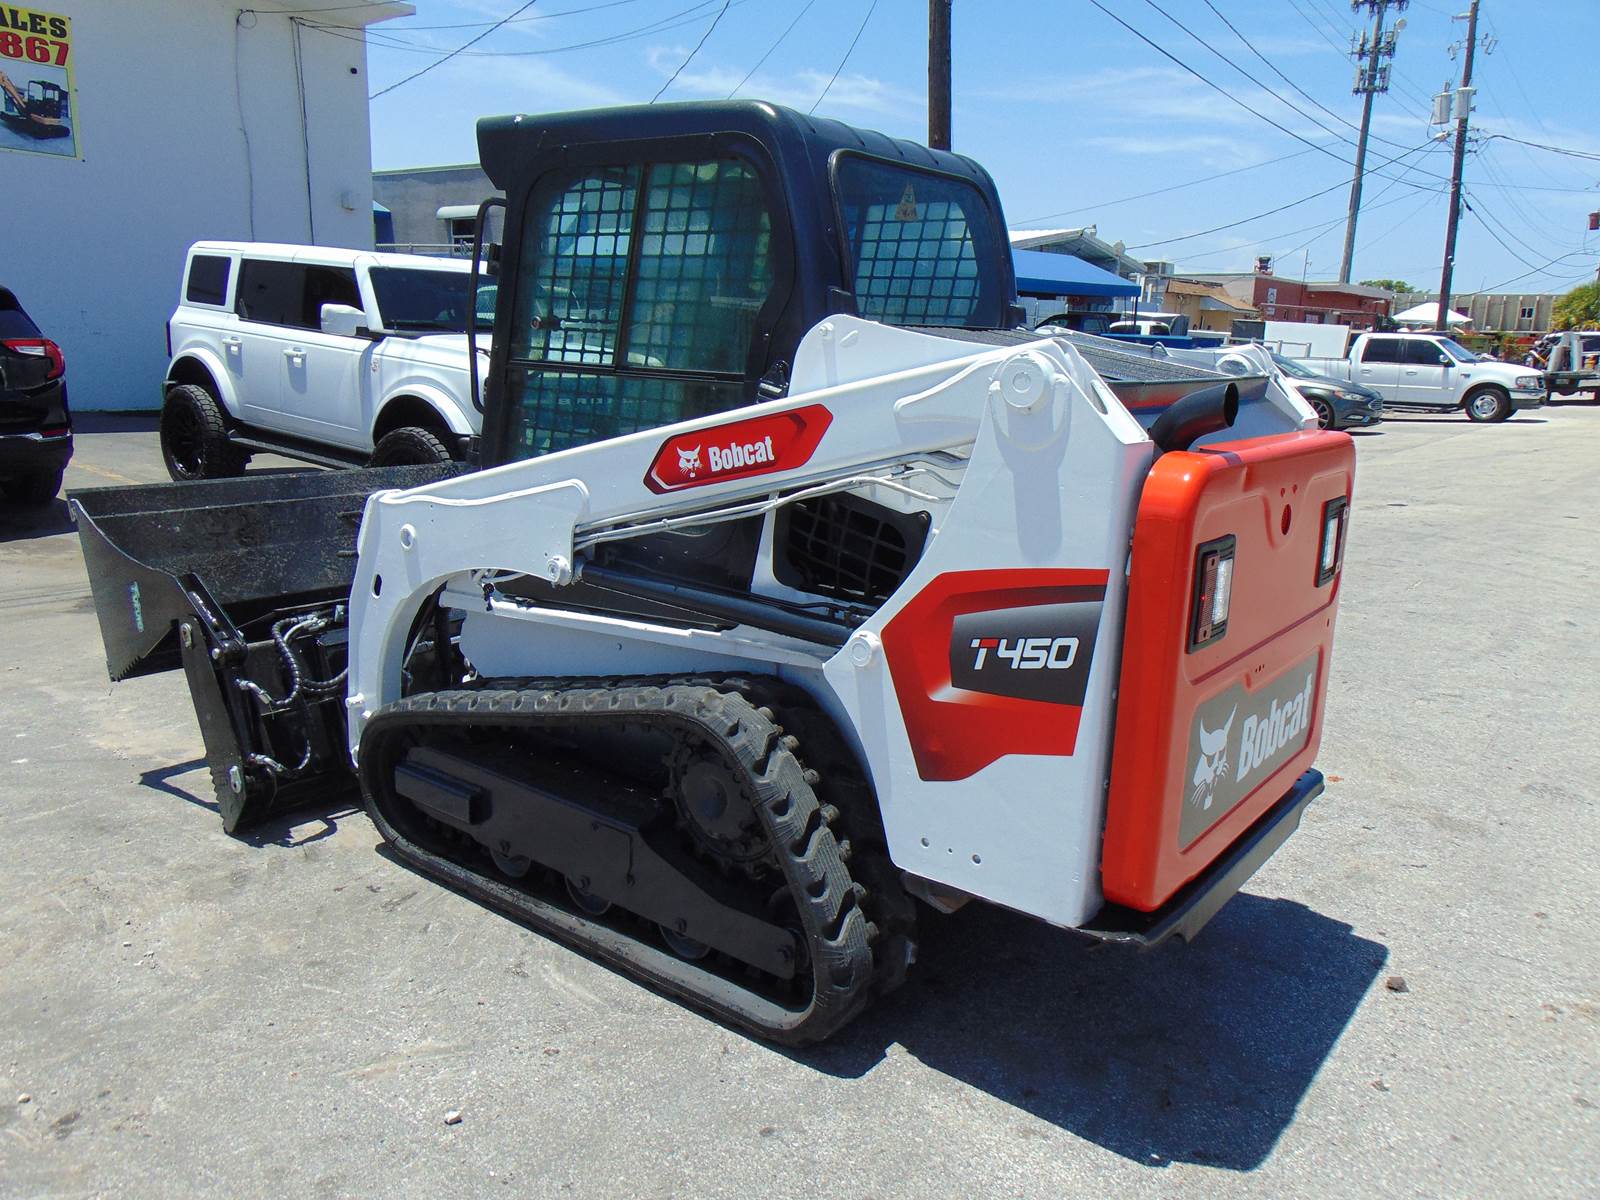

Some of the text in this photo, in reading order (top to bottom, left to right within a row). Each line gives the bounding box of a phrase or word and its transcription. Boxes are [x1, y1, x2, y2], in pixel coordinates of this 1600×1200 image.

[0, 31, 69, 66] 867
[708, 436, 774, 472] Bobcat
[971, 637, 1080, 670] T450
[1236, 672, 1313, 783] Bobcat
